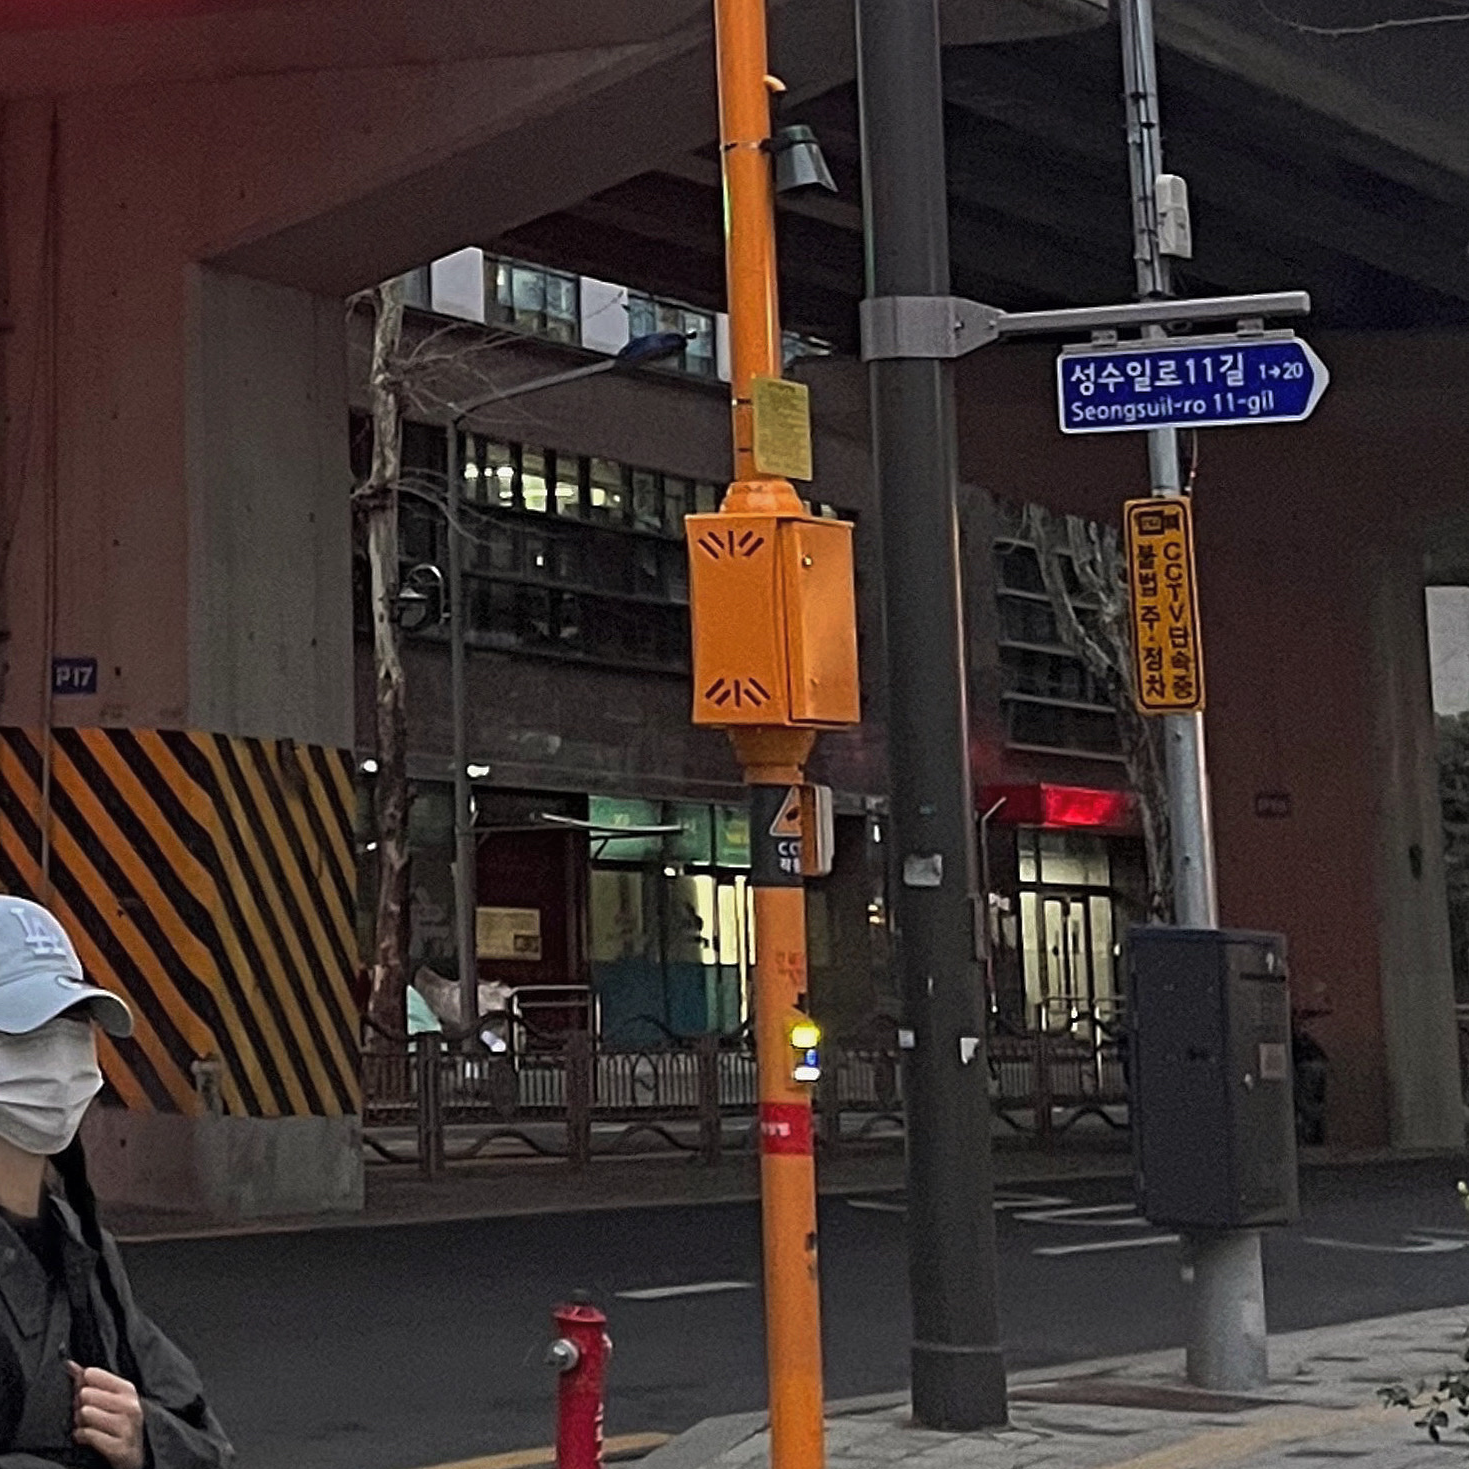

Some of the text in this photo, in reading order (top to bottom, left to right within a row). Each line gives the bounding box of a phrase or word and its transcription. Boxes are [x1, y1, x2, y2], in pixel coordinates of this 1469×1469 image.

[1070, 351, 1245, 396] 성수일로11길
[1070, 390, 1275, 422] Seongsuil-ro 11-gil
[56, 665, 94, 687] P17
[9, 906, 67, 958] LA
